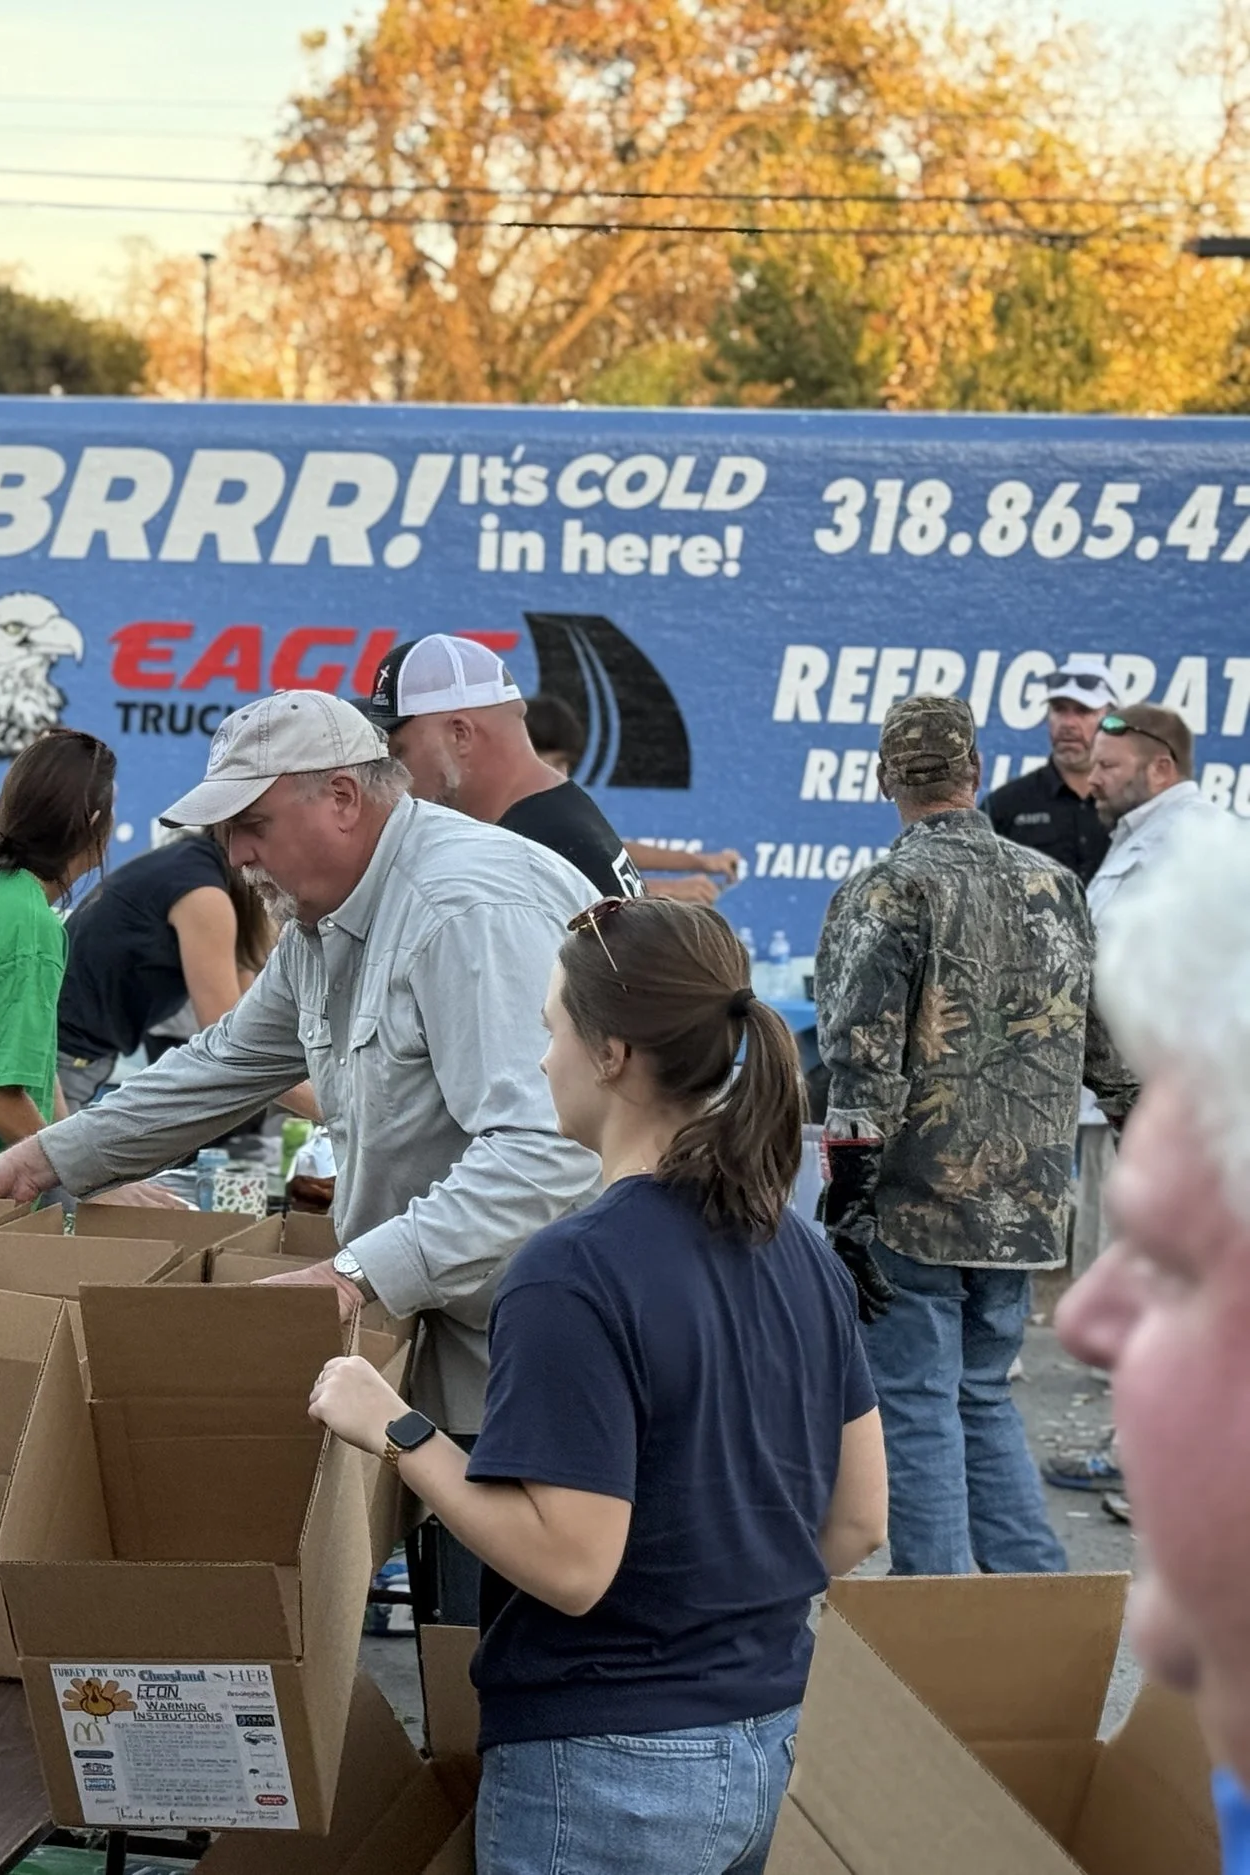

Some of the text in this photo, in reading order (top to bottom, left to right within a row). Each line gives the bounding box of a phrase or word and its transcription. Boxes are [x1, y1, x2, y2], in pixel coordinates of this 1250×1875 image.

[458, 444, 768, 511] It's COLD
[478, 512, 744, 578] in here!
[116, 701, 235, 736] TRUC
[53, 1667, 86, 1678] TURKEY
[133, 1710, 223, 1721] INSTRUCTIONS
[144, 1701, 207, 1711] WARMING
